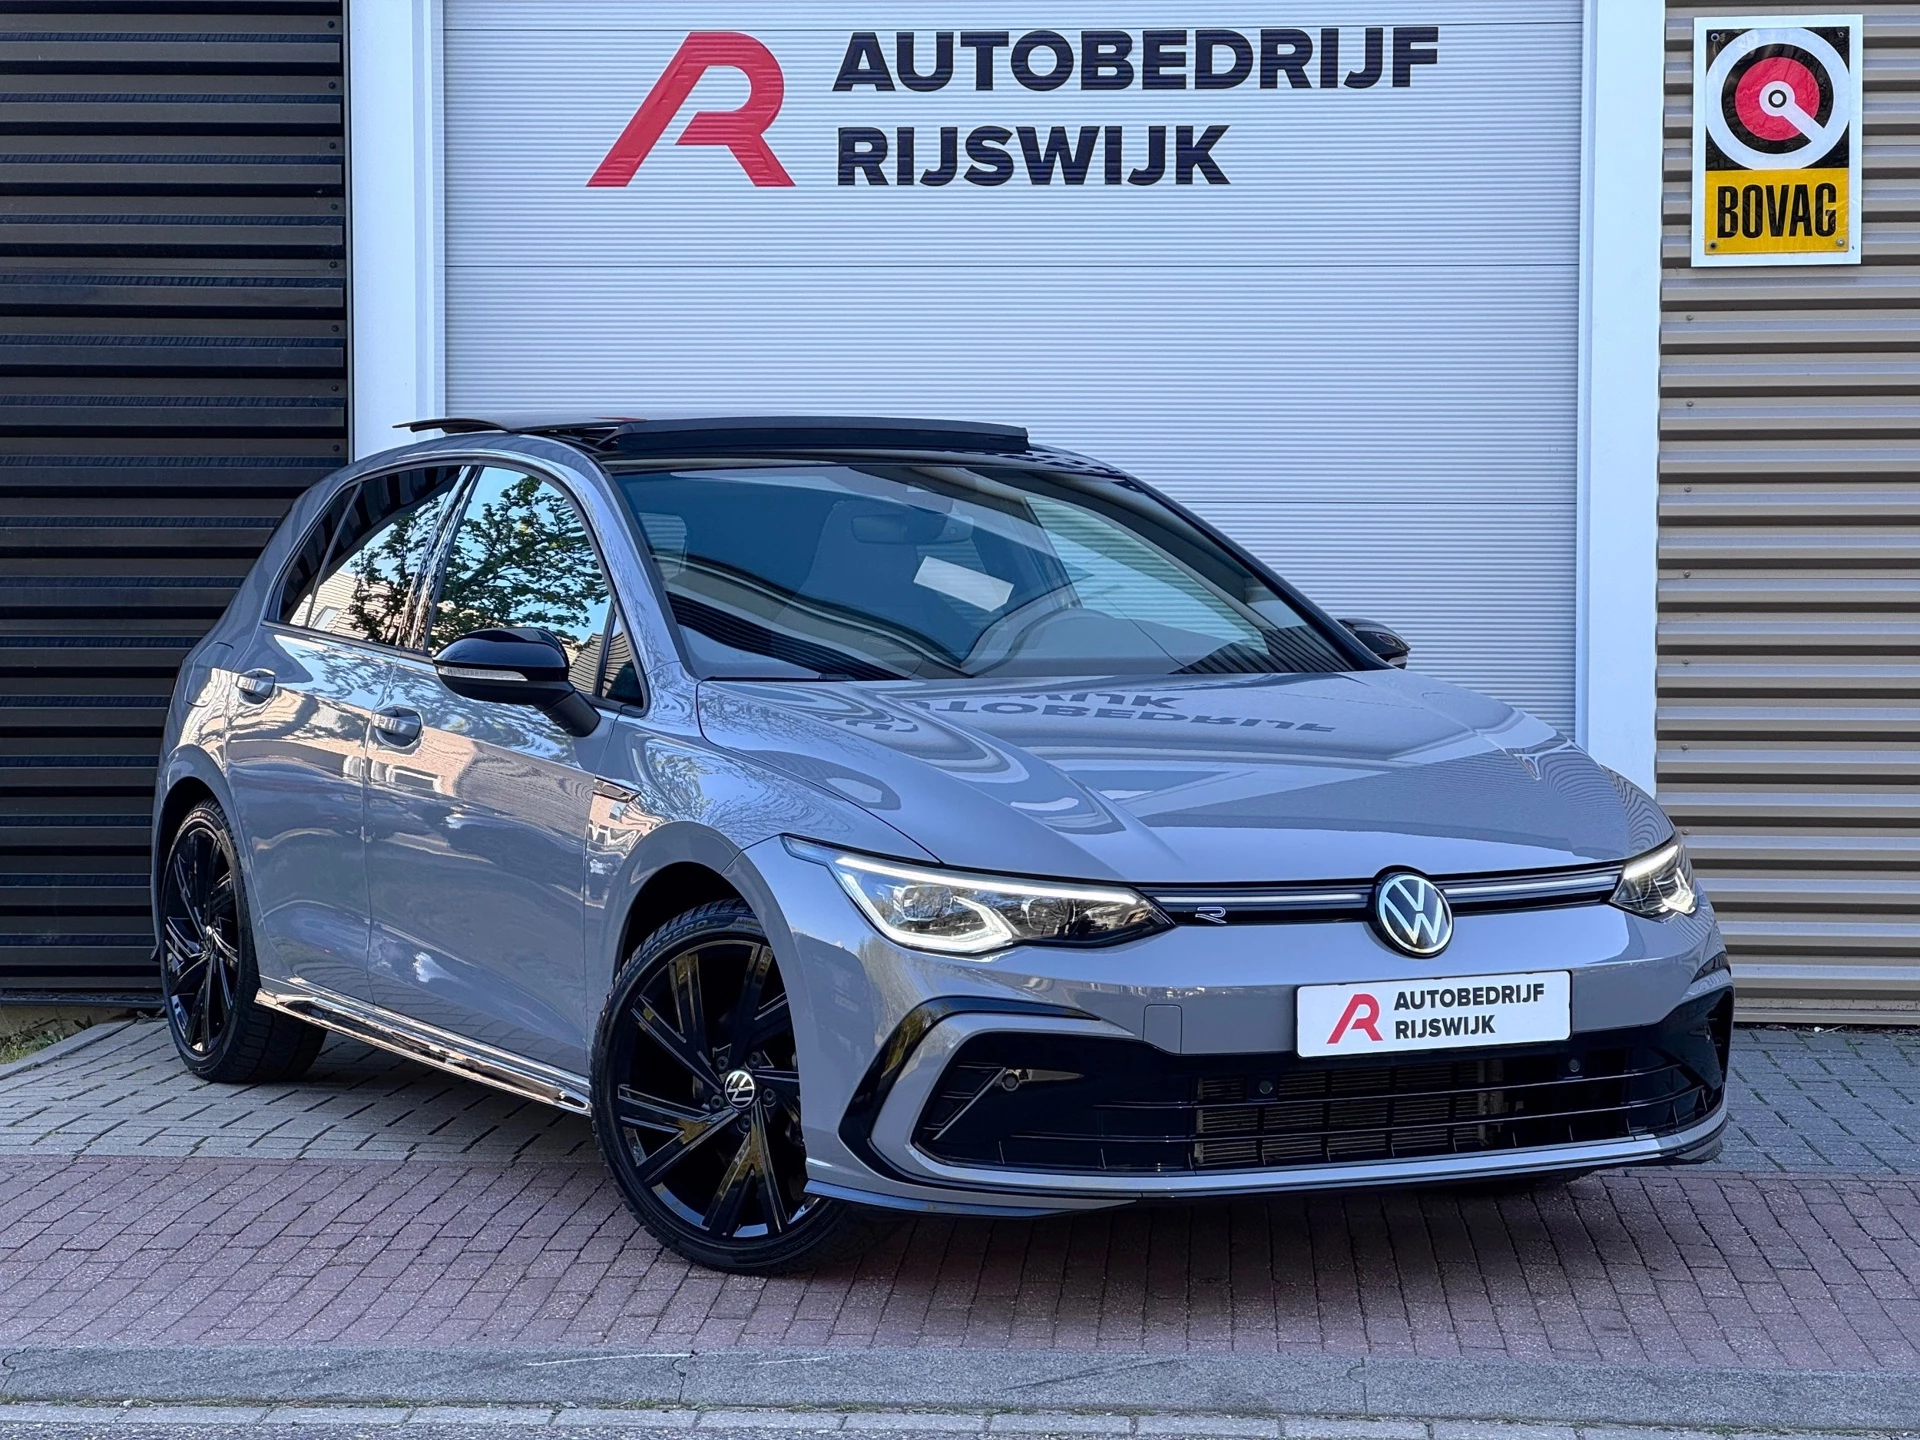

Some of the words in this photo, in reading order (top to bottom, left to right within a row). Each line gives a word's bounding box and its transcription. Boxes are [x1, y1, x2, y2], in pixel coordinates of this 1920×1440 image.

[833, 26, 1440, 92] AUTOBEDRIJF
[837, 124, 1231, 187] RIJSWIJK
[1716, 183, 1837, 239] BOVAG
[1393, 982, 1545, 1011] AUTOBEDRIJF
[1395, 1014, 1496, 1040] RIJSWIJK
